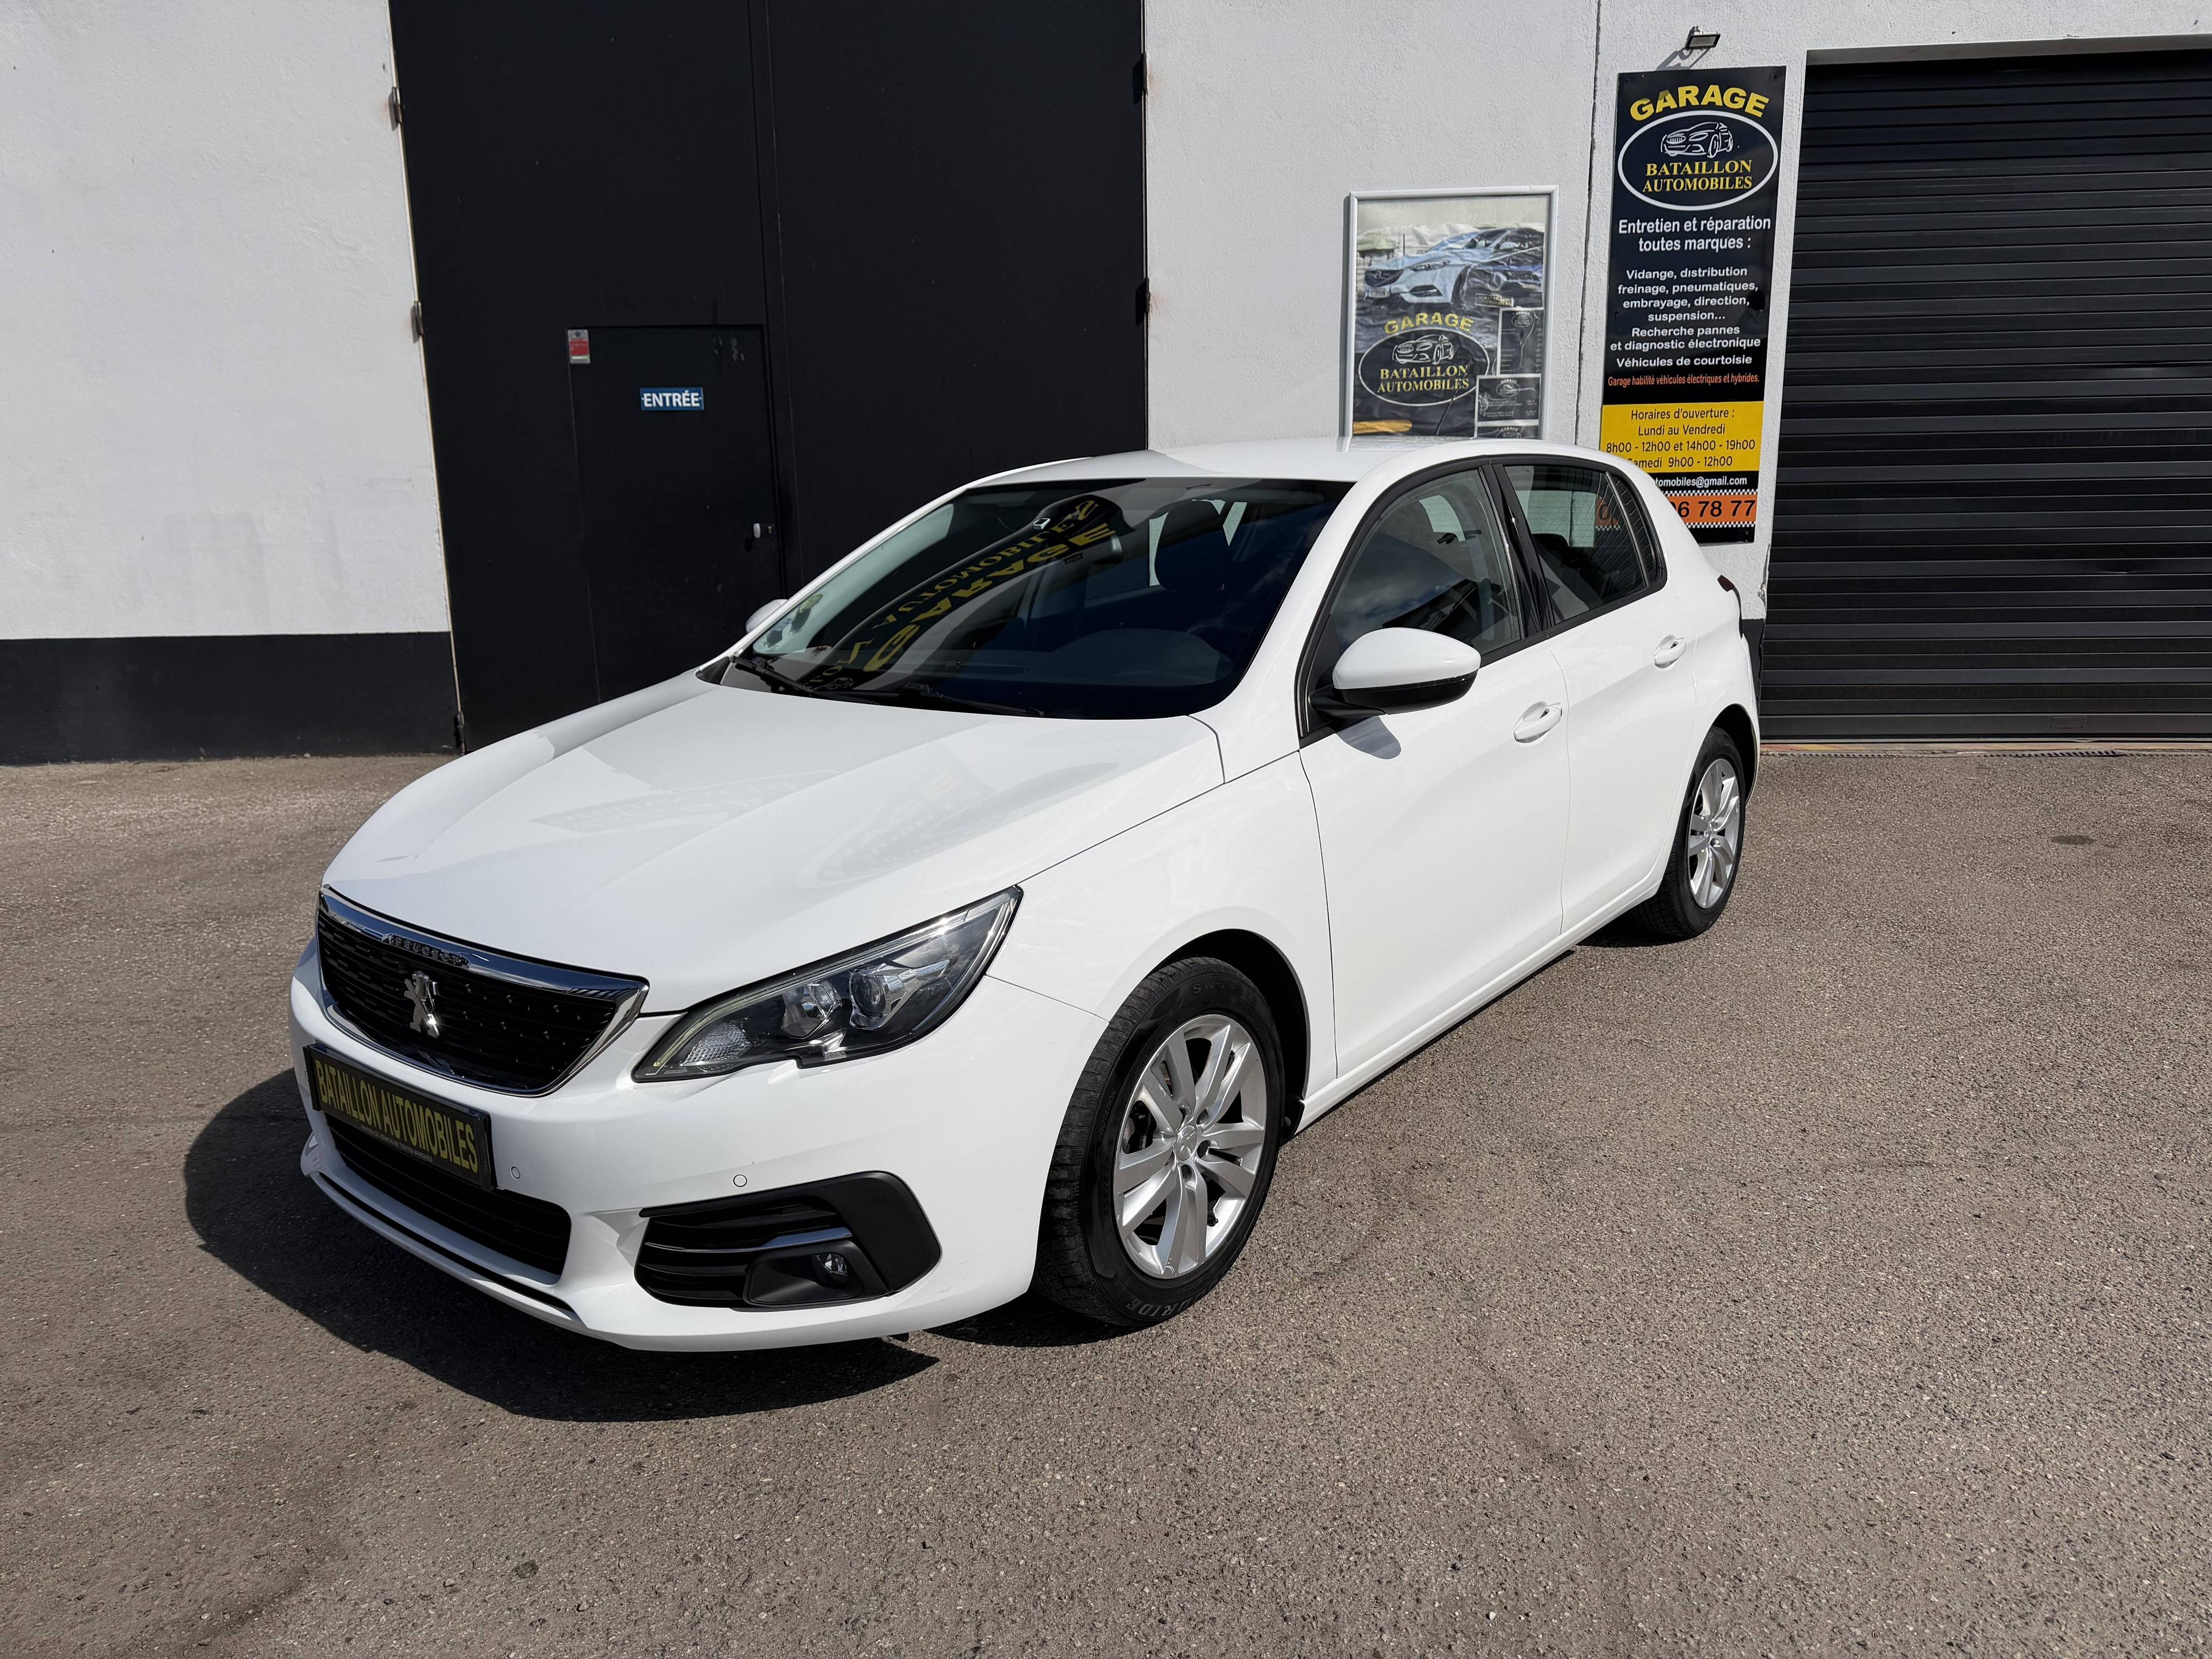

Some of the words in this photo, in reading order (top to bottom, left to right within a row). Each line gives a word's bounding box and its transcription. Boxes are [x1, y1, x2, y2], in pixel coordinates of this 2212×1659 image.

[1630, 85, 1769, 120] GARAGE
[1646, 160, 1752, 176] BATAILLON
[1642, 176, 1752, 192] AUTOMOBILES
[1619, 218, 1680, 234] Entretien
[1684, 217, 1697, 232] et
[1700, 215, 1771, 234] réparation
[1639, 237, 1680, 251] toutes
[1685, 237, 1743, 252] marques
[1626, 269, 1677, 280] Vidange,
[1680, 267, 1747, 278] distribution
[1618, 283, 1669, 295] freinage,
[1672, 282, 1758, 294] pneumatiques,
[1623, 298, 1691, 309] embrayage,
[1694, 297, 1749, 307] direction,
[1384, 312, 1475, 335] GARAGE
[1647, 311, 1726, 323] suspension...
[1632, 327, 1694, 337] Recherche
[1698, 326, 1740, 337] pannes
[1610, 341, 1622, 351] et
[1624, 339, 1685, 352] diagnostic
[1688, 338, 1761, 349] électronique
[1616, 357, 1673, 368] Véhicules
[1676, 357, 1691, 366] de
[1694, 355, 1752, 366] courtoisie
[1380, 365, 1468, 380] BATAILLON
[1377, 378, 1469, 393] AUTOMOBILES
[1608, 377, 1631, 388] Garage
[1632, 374, 1655, 385] habilité
[1656, 374, 1686, 384] véhicules
[1687, 373, 1722, 385] électriques
[1723, 373, 1730, 383] et
[1730, 373, 1760, 384] hybrides.
[643, 389, 700, 407] ENTRÉE
[1631, 408, 1671, 420] Horaires
[1673, 409, 1729, 418] d'ouverture
[1638, 425, 1665, 436] Lundi
[1668, 427, 1679, 435] au
[1683, 423, 1725, 435] Vendredi
[1606, 442, 1631, 453] 8h00
[1642, 441, 1671, 452] 12h00
[1673, 442, 1683, 451] et
[1686, 440, 1716, 451] 14h00
[1726, 439, 1755, 450] 19h00
[1668, 457, 1694, 468] 9h00
[1704, 456, 1733, 467] 12h00
[1655, 476, 1748, 488] tomobiles@gmail.com
[1698, 501, 1722, 517] 78
[1730, 499, 1756, 517] 77
[315, 1059, 382, 1130] BATAILLON
[381, 1089, 478, 1173] AUTOMOBILES
